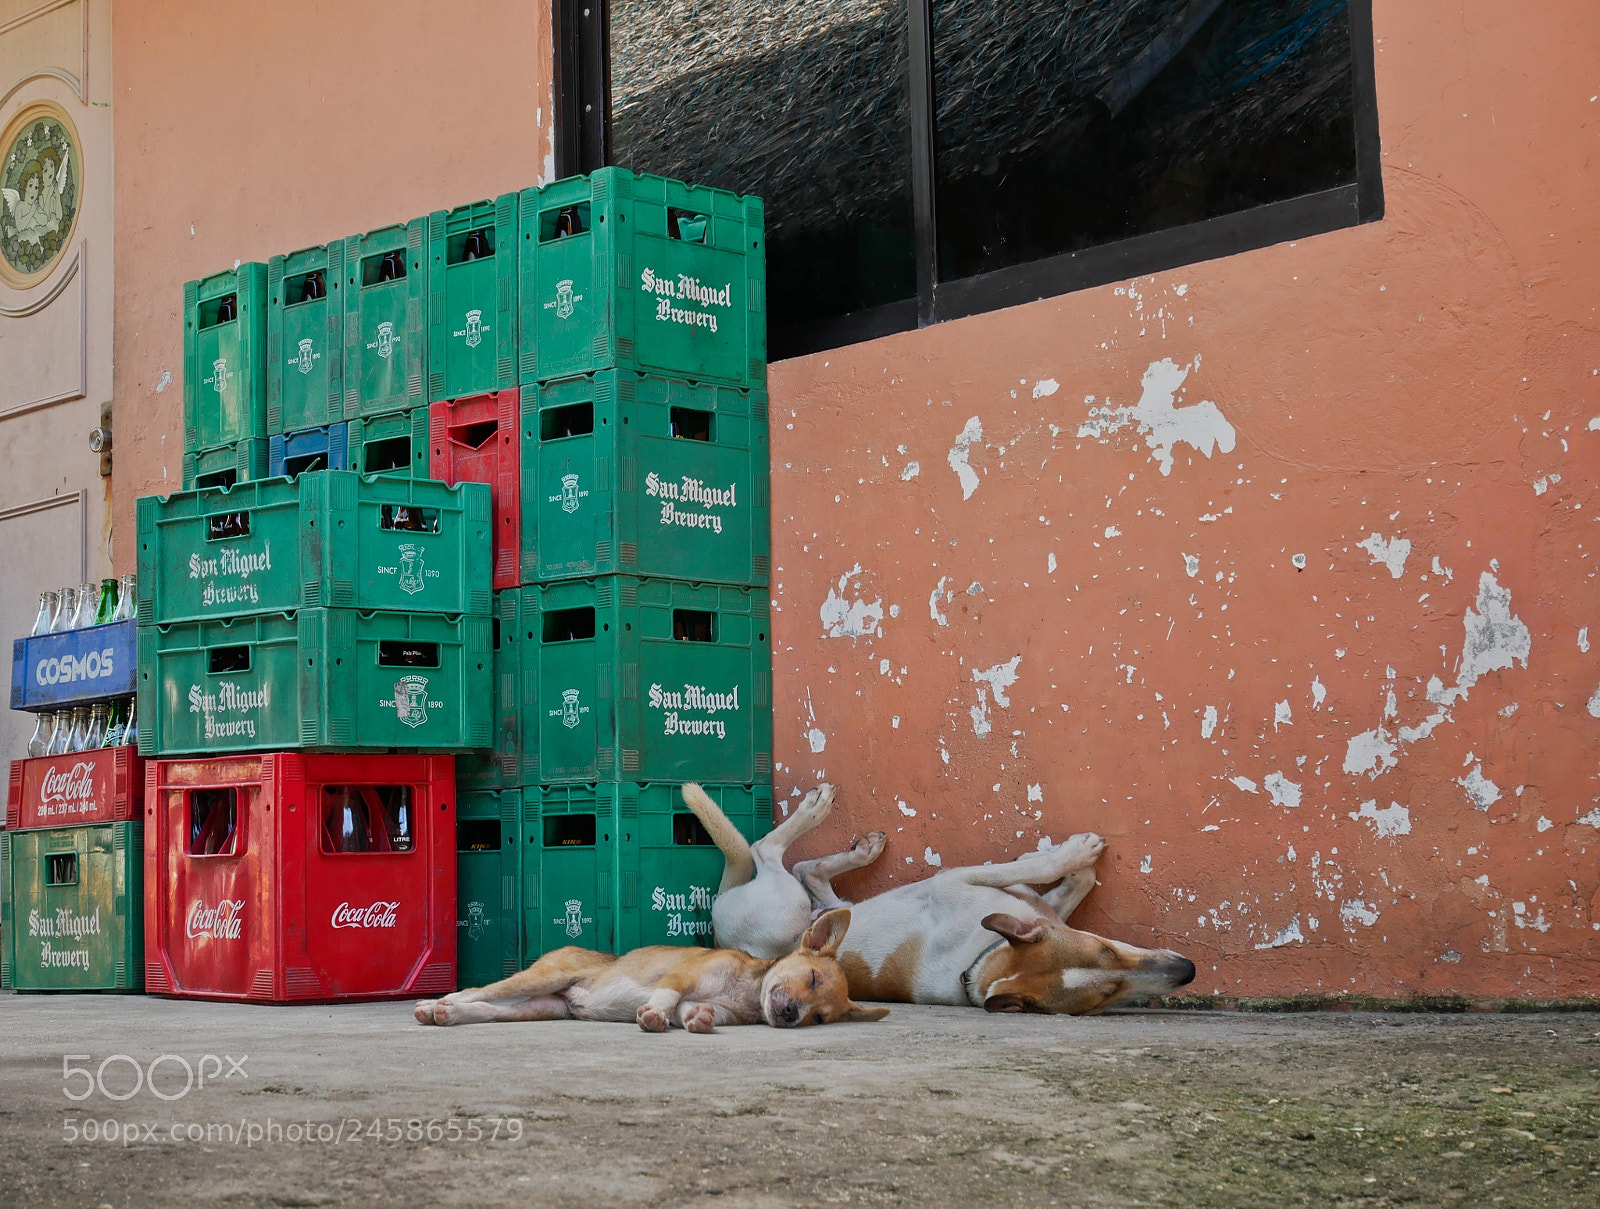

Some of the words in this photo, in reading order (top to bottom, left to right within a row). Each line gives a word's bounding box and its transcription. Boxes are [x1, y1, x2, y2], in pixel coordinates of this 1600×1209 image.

[641, 267, 676, 297] San
[676, 273, 731, 307] Miguel
[655, 297, 718, 333] Brewery
[645, 471, 679, 499] San
[680, 475, 737, 509] Miguel
[660, 501, 723, 534] Brewery
[36, 648, 114, 686] COSMOS
[188, 684, 217, 713] San
[218, 681, 269, 713] Miguel
[379, 699, 396, 708] SINC
[428, 701, 444, 709] 1890
[648, 683, 682, 710] San
[683, 684, 739, 714] Miguel
[204, 715, 256, 739] Brewery
[664, 712, 726, 740] Brewery
[651, 886, 687, 911] San
[29, 908, 55, 937] San
[55, 905, 101, 942] Miguel
[331, 901, 400, 929] Coca-Cola
[666, 912, 714, 937] Brewe
[41, 941, 90, 972] Brewery
